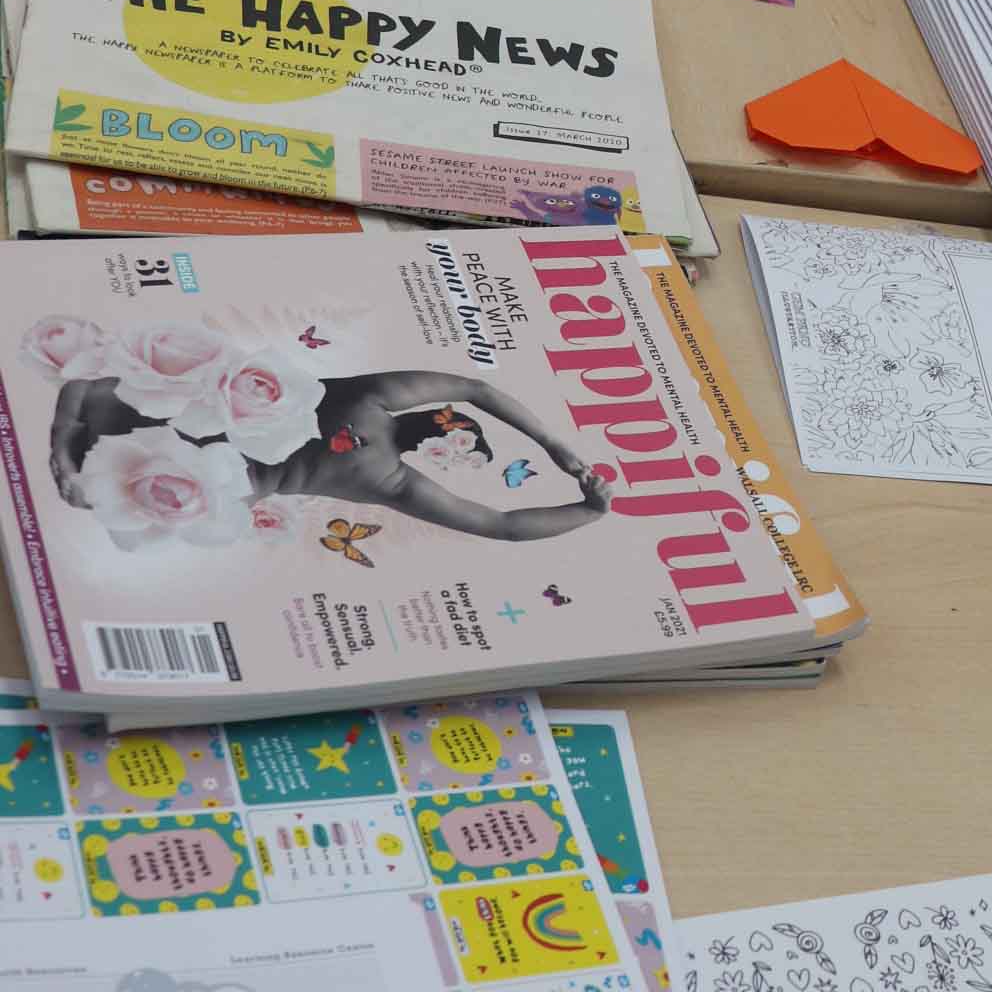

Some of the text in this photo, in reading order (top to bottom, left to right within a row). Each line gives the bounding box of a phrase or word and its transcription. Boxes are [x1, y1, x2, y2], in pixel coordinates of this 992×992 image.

[70, 31, 96, 43] THE
[101, 39, 137, 52] HAPPY
[235, 62, 245, 70] A
[250, 64, 313, 81] PLATFORM
[319, 75, 337, 84] TO
[386, 84, 435, 99] POSITIVE
[441, 91, 471, 104] NEWS
[479, 96, 501, 107] AND
[158, 40, 168, 49] A
[173, 44, 241, 61] NEWSPAPER
[247, 55, 264, 64] TO
[272, 59, 338, 76] CELEBRATE
[346, 70, 363, 79] ALL
[415, 78, 449, 91] GOOD
[455, 84, 466, 93] IN
[471, 86, 495, 97] THE
[220, 30, 252, 47] BY
[265, 37, 342, 59] EMILY
[456, 20, 618, 78] NEWS
[101, 108, 288, 157] BLOOM
[369, 148, 615, 185] SESAME STREET LAUNCH SHOW FOR
[369, 158, 567, 189] CHILDREN AFFECTED BY WAR
[135, 258, 174, 288] 31
[493, 276, 528, 322] MAKE
[424, 241, 469, 299] your
[455, 304, 500, 365] body
[461, 252, 516, 350] PEACE WITH
[608, 260, 701, 445] THE MAGAZINE DEVOTED TO MENTAL HEALTH
[654, 271, 750, 453] THE MAGAZINE DEVOTED TO MENTAL HEALTH
[519, 235, 799, 634] happiful
[734, 467, 814, 594] WALSALL COLLEGE LRC
[310, 592, 350, 670] Empowered.
[333, 602, 363, 655] Sensual.
[353, 605, 376, 650] Strong.
[443, 600, 464, 620] fad
[455, 582, 492, 650] How to spot
[657, 595, 677, 613] JAN
[452, 623, 473, 645] diet
